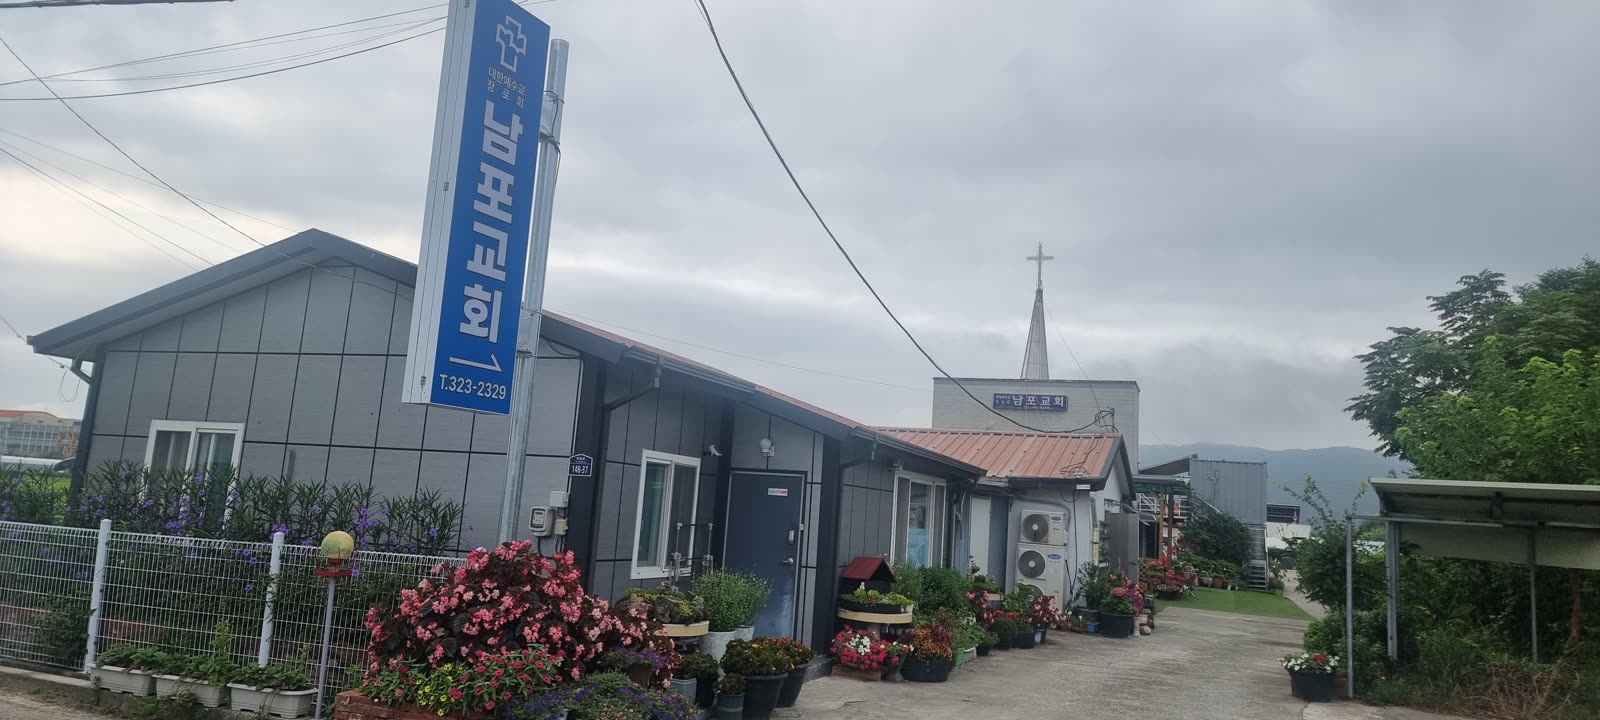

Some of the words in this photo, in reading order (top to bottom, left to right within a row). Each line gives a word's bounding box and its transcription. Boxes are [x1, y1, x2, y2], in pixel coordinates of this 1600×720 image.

[488, 67, 526, 96] 대한예수교
[459, 100, 524, 343] 남포교회
[440, 373, 507, 400] T.323-2329
